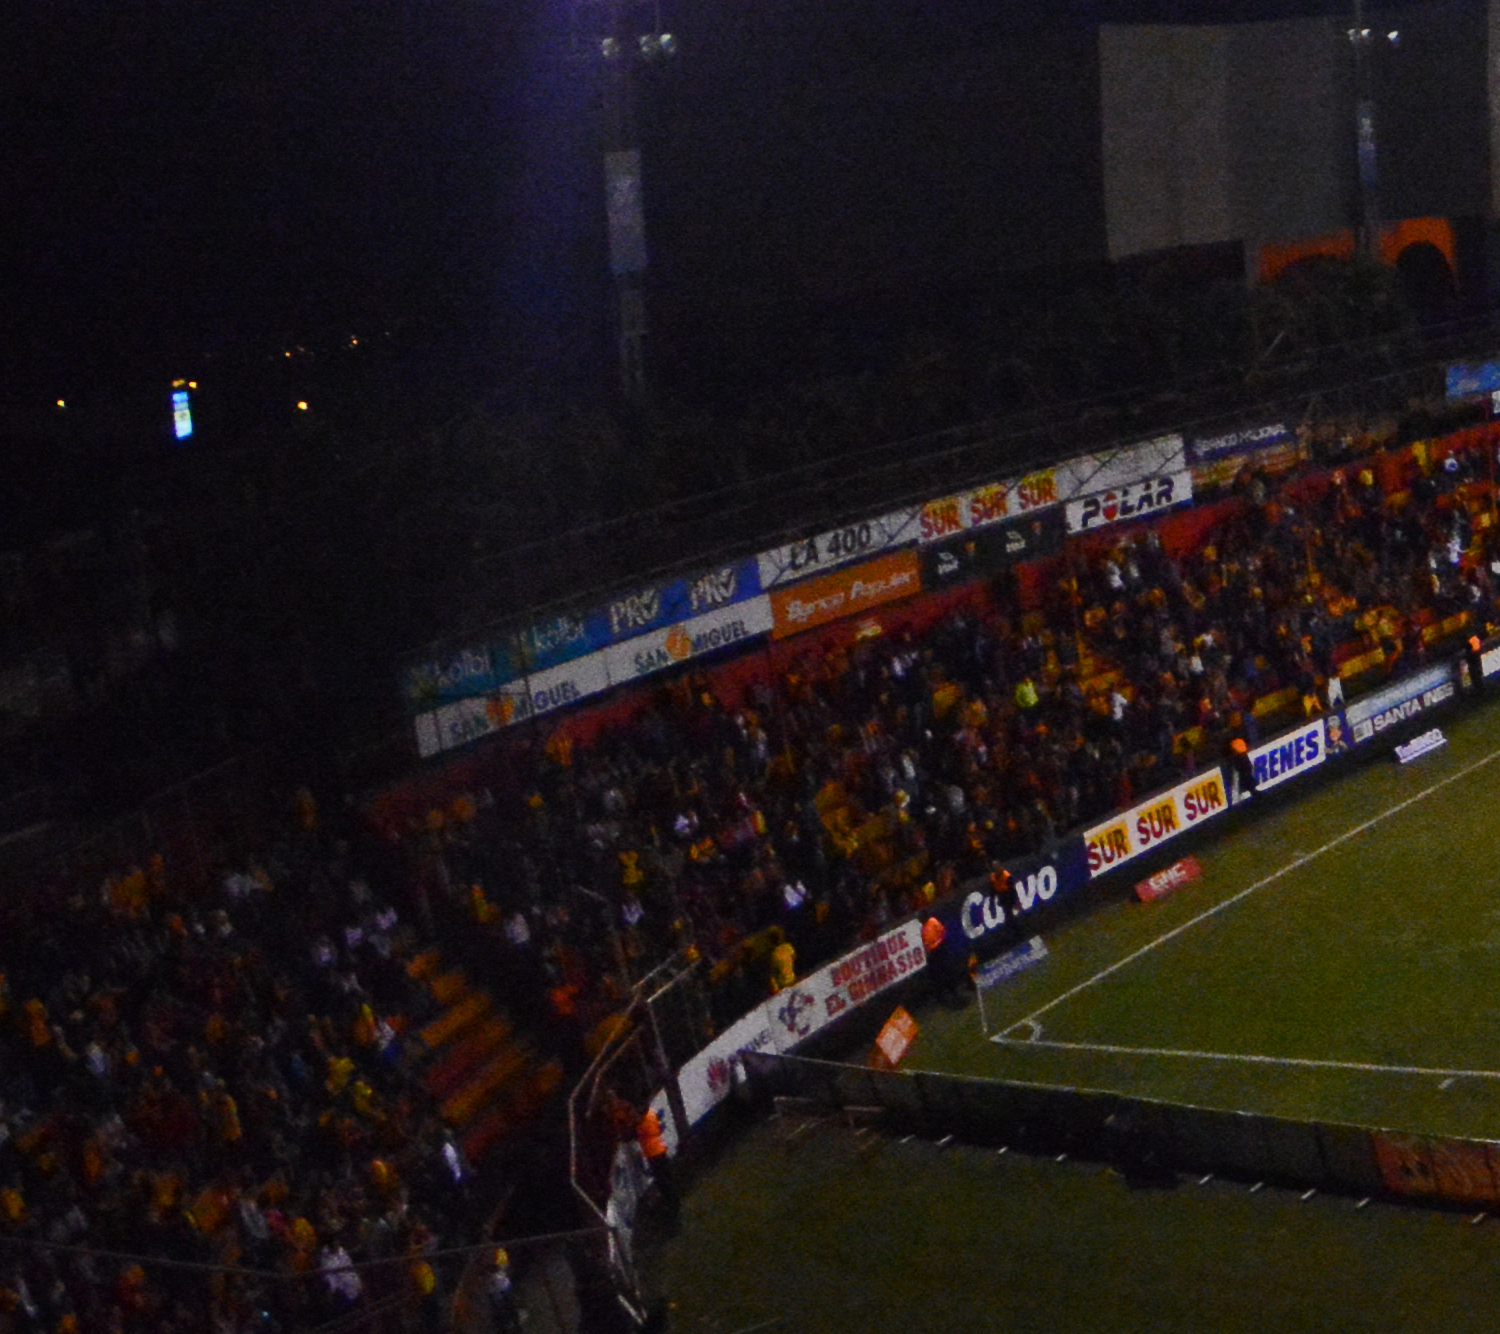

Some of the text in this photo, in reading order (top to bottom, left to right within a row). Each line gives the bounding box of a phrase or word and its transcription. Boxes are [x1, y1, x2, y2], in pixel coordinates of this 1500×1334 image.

[971, 484, 1009, 527] SUR
[1018, 470, 1056, 508] SUR
[828, 525, 871, 557] 400
[920, 503, 962, 539] SUR
[690, 621, 749, 652] MIGUEL
[1374, 698, 1421, 732] SANTA
[1252, 729, 1320, 785] RENES
[1184, 774, 1223, 821] SUR
[1137, 796, 1177, 846] SUR
[1087, 821, 1130, 873] SUR
